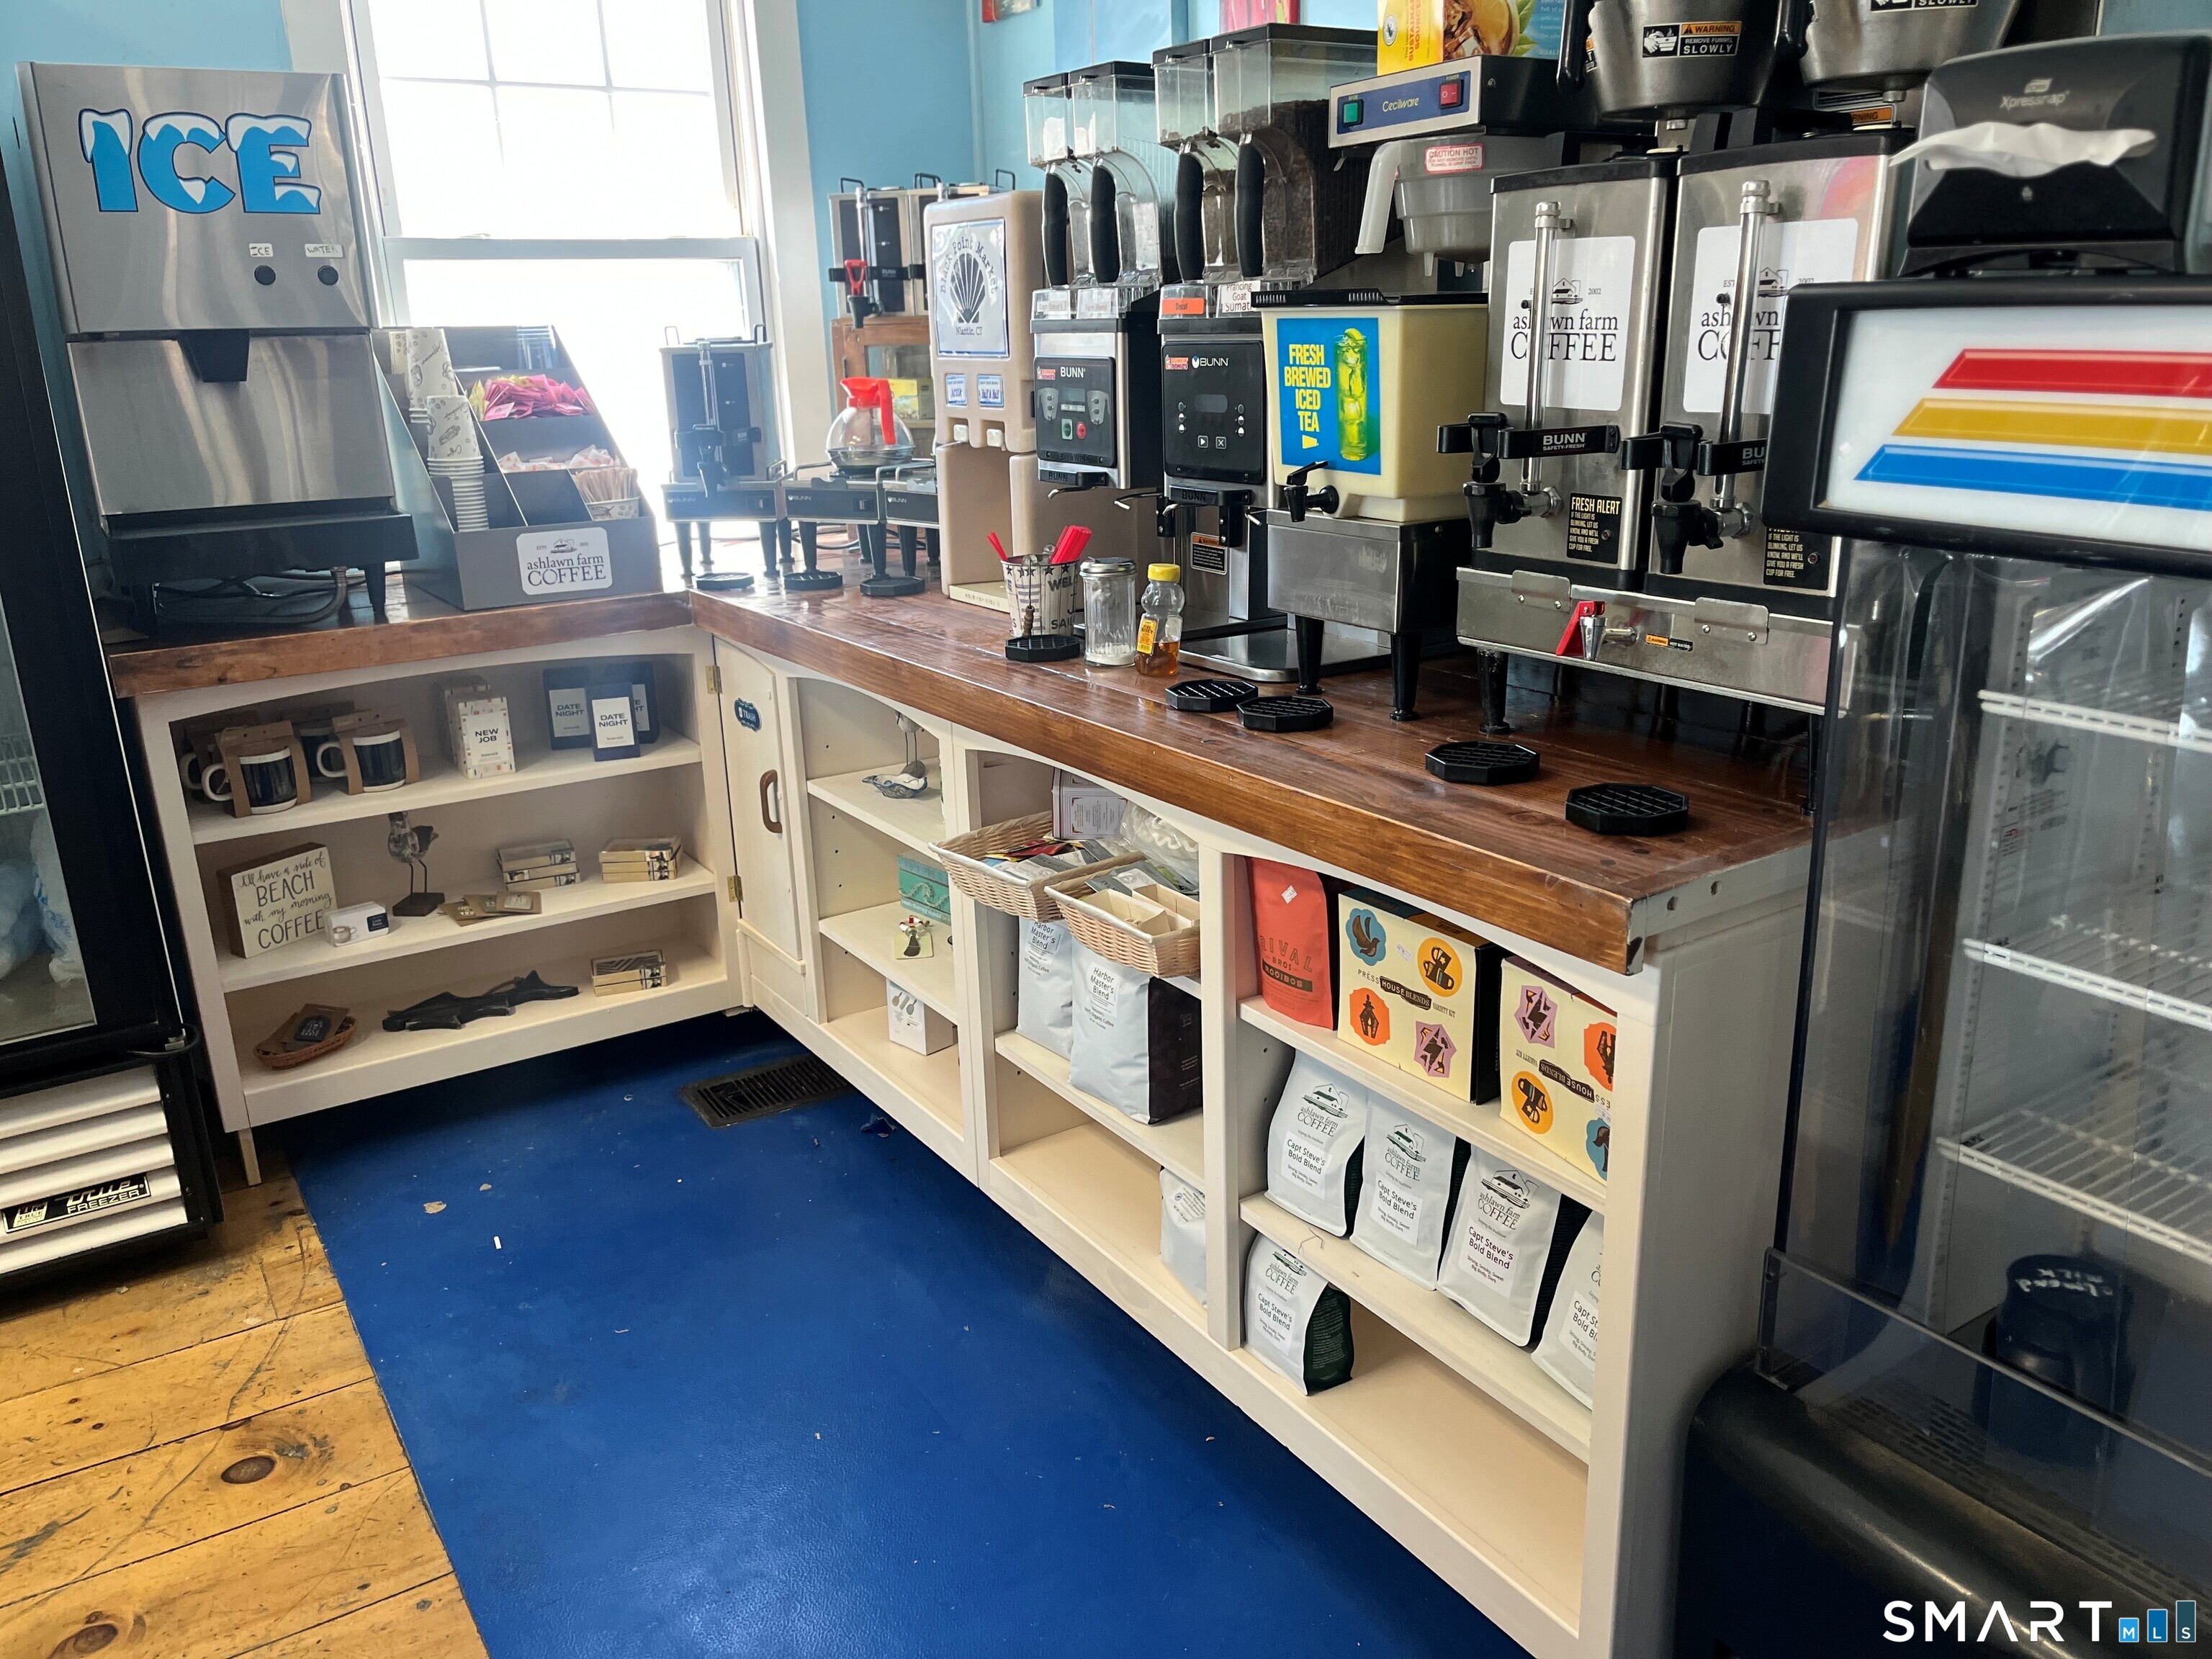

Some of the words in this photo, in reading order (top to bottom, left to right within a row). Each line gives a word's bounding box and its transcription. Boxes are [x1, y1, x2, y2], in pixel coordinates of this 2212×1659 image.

[1694, 24, 1735, 33] WARNING
[1683, 44, 1733, 55] SLOWLY
[1382, 97, 1419, 112] Cecilware
[78, 108, 321, 215] ICE
[250, 246, 271, 256] ICE
[952, 236, 974, 254] Point
[976, 242, 999, 294] Market
[1226, 282, 1252, 292] Prancing
[1233, 292, 1246, 301] Goat
[1579, 308, 1618, 331] farm
[1289, 344, 1325, 365] FRESH
[1511, 331, 1617, 361] CFFEE
[1060, 367, 1084, 378] BUNN
[1200, 358, 1229, 367] BUNN
[1285, 366, 1331, 388] BREWED
[1295, 389, 1321, 410] ICED
[1298, 411, 1320, 432] TEA
[1543, 433, 1586, 446] BUNN
[1742, 447, 1764, 459] BU
[1048, 472, 1068, 482] BUNN
[1182, 490, 1206, 502] BUNN
[1571, 497, 1595, 512] FRESH
[1596, 499, 1620, 515] ALERT
[527, 557, 574, 570] ashlawn
[577, 554, 603, 565] farm
[528, 565, 606, 586] COFFEE
[743, 709, 756, 722] TRASH
[475, 728, 498, 737] NEW
[258, 869, 282, 883] have
[314, 851, 325, 868] of
[256, 870, 315, 907] BEACH
[244, 909, 265, 925] with
[268, 907, 286, 922] my
[290, 892, 333, 909] morning
[258, 909, 325, 949] COFFEE
[1031, 927, 1056, 944] Master's
[1034, 921, 1054, 934] Harbor
[1032, 936, 1048, 950] Blend
[1259, 936, 1313, 972] RIVAL
[1272, 956, 1292, 971] BROS
[1090, 975, 1114, 994] Master's
[1094, 967, 1114, 984] Harbor
[1264, 965, 1303, 988] ROOIBOS
[1092, 986, 1109, 1000] Blend
[1382, 981, 1404, 996] HOUSE
[1406, 992, 1429, 1007] BLENDS
[1540, 1063, 1566, 1083] BLENDS
[1566, 1078, 1591, 1098] HOUSE
[1298, 1112, 1336, 1138] COFFEE
[1300, 1106, 1324, 1123] ashlawn
[1324, 1115, 1338, 1128] farm
[1287, 1139, 1302, 1153] Capt
[1303, 1148, 1326, 1166] Steve's
[1288, 1149, 1302, 1163] Bold
[1304, 1159, 1321, 1174] Blend
[1387, 1146, 1405, 1165] ashlawn
[1406, 1158, 1420, 1172] farm
[1385, 1152, 1421, 1182] COFFEE
[68, 1190, 140, 1214] FREEZER
[1377, 1179, 1390, 1196] Capt
[1391, 1189, 1417, 1211] Steve's
[1379, 1190, 1391, 1207] Bold
[1393, 1202, 1414, 1220] Blend
[1480, 1192, 1504, 1212] ashlawn
[1506, 1204, 1520, 1219] farm
[1478, 1199, 1518, 1230] COFFEE
[1469, 1226, 1484, 1243] Capt
[1485, 1238, 1514, 1260] Steve's
[1469, 1238, 1485, 1254] Bold
[1486, 1251, 1510, 1269] Blend
[1266, 1268, 1297, 1295] COFFEE
[1269, 1263, 1287, 1279] ashlawn
[1287, 1273, 1298, 1286] farm
[1258, 1293, 1270, 1308] Capt
[1272, 1303, 1292, 1323] Steve's
[1259, 1303, 1272, 1318] Bold
[1272, 1315, 1290, 1331] Blend
[1574, 1300, 1591, 1320] Capt
[1573, 1313, 1589, 1333] Bold
